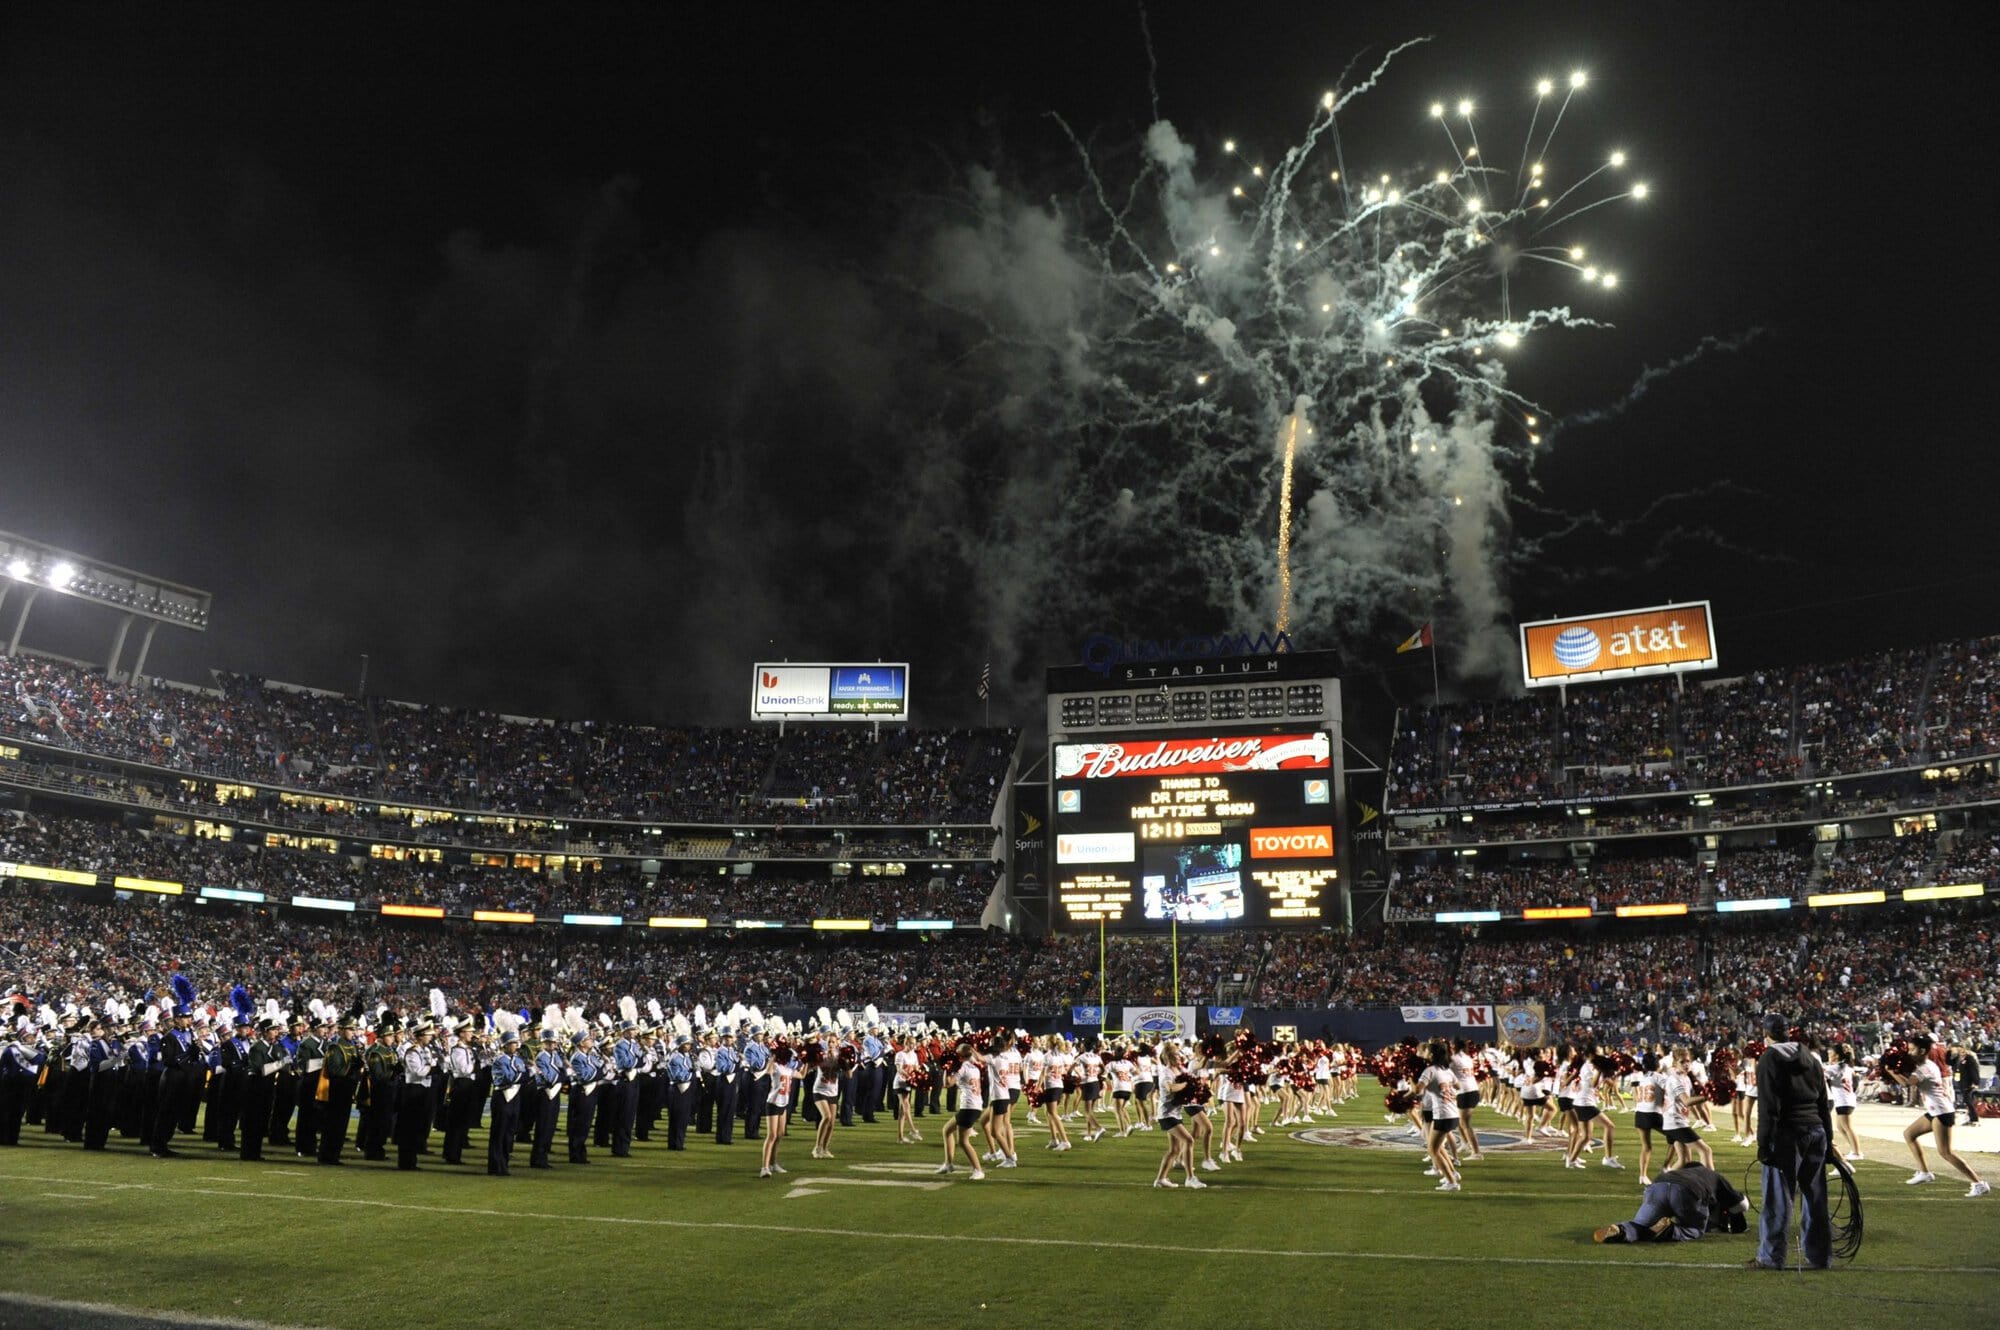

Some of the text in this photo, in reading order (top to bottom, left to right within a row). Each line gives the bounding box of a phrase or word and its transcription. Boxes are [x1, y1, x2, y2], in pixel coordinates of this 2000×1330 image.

[1609, 620, 1688, 656] at&t
[1126, 661, 1278, 678] STADIUM
[761, 696, 825, 705] UnionBank
[833, 702, 856, 710] ready.
[1080, 738, 1262, 778] Budweiser
[1160, 777, 1220, 789] THANKS TO
[1151, 789, 1229, 804] DR PEPPER
[1131, 802, 1255, 819] HALFTIME SHOW
[1254, 835, 1329, 851] TOYOTA
[1352, 830, 1383, 842] Sprint
[1015, 840, 1043, 850] Sprint
[1140, 1012, 1164, 1023] PACIFIC
[1466, 1008, 1486, 1025] N
[1275, 1027, 1295, 1041] 25
